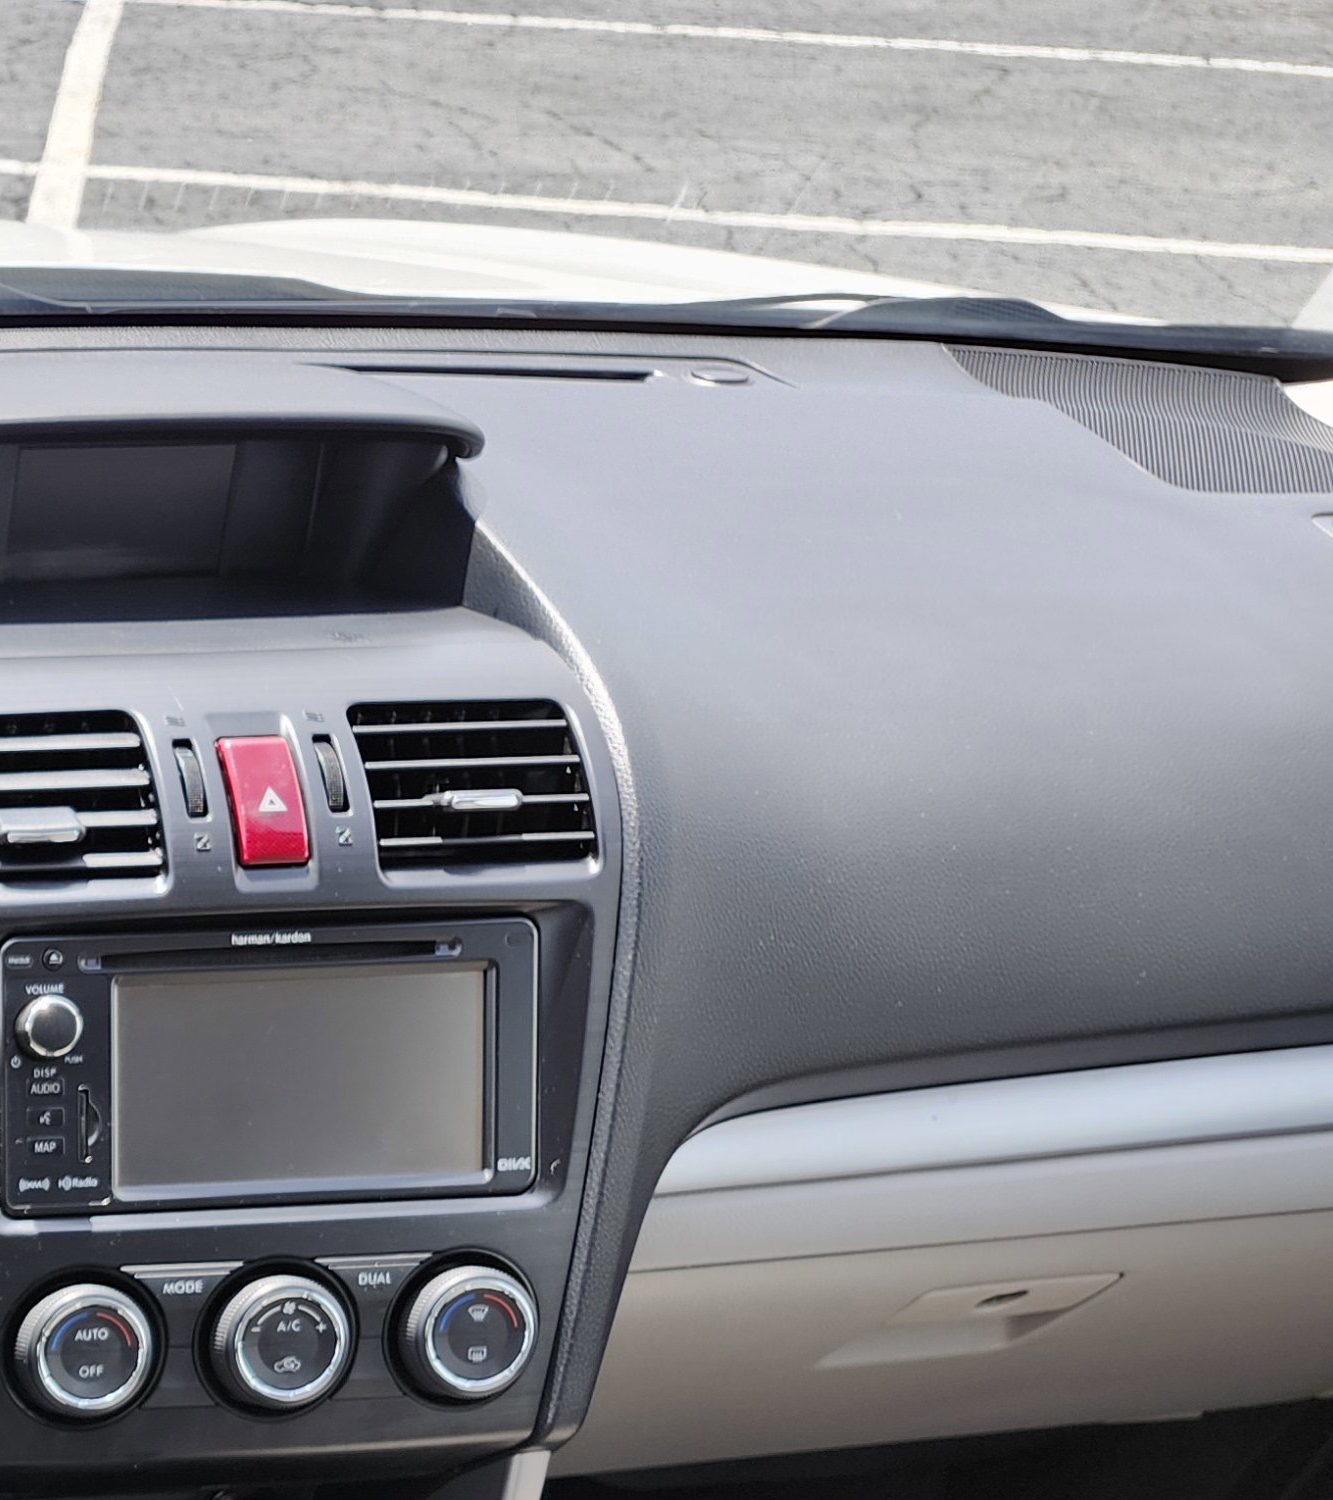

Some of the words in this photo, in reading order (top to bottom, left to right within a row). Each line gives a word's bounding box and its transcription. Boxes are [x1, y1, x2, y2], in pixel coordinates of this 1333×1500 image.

[231, 931, 312, 946] harman/kardon
[25, 983, 65, 995] VOLUME
[33, 1067, 57, 1079] DISP
[30, 1083, 61, 1095] AUDIO
[34, 1141, 56, 1153] MAP
[358, 1272, 391, 1286] DUAL
[162, 1279, 204, 1295] MODE
[276, 1319, 302, 1333] A/C
[74, 1327, 109, 1341] AUTO
[78, 1364, 104, 1379] OFF
